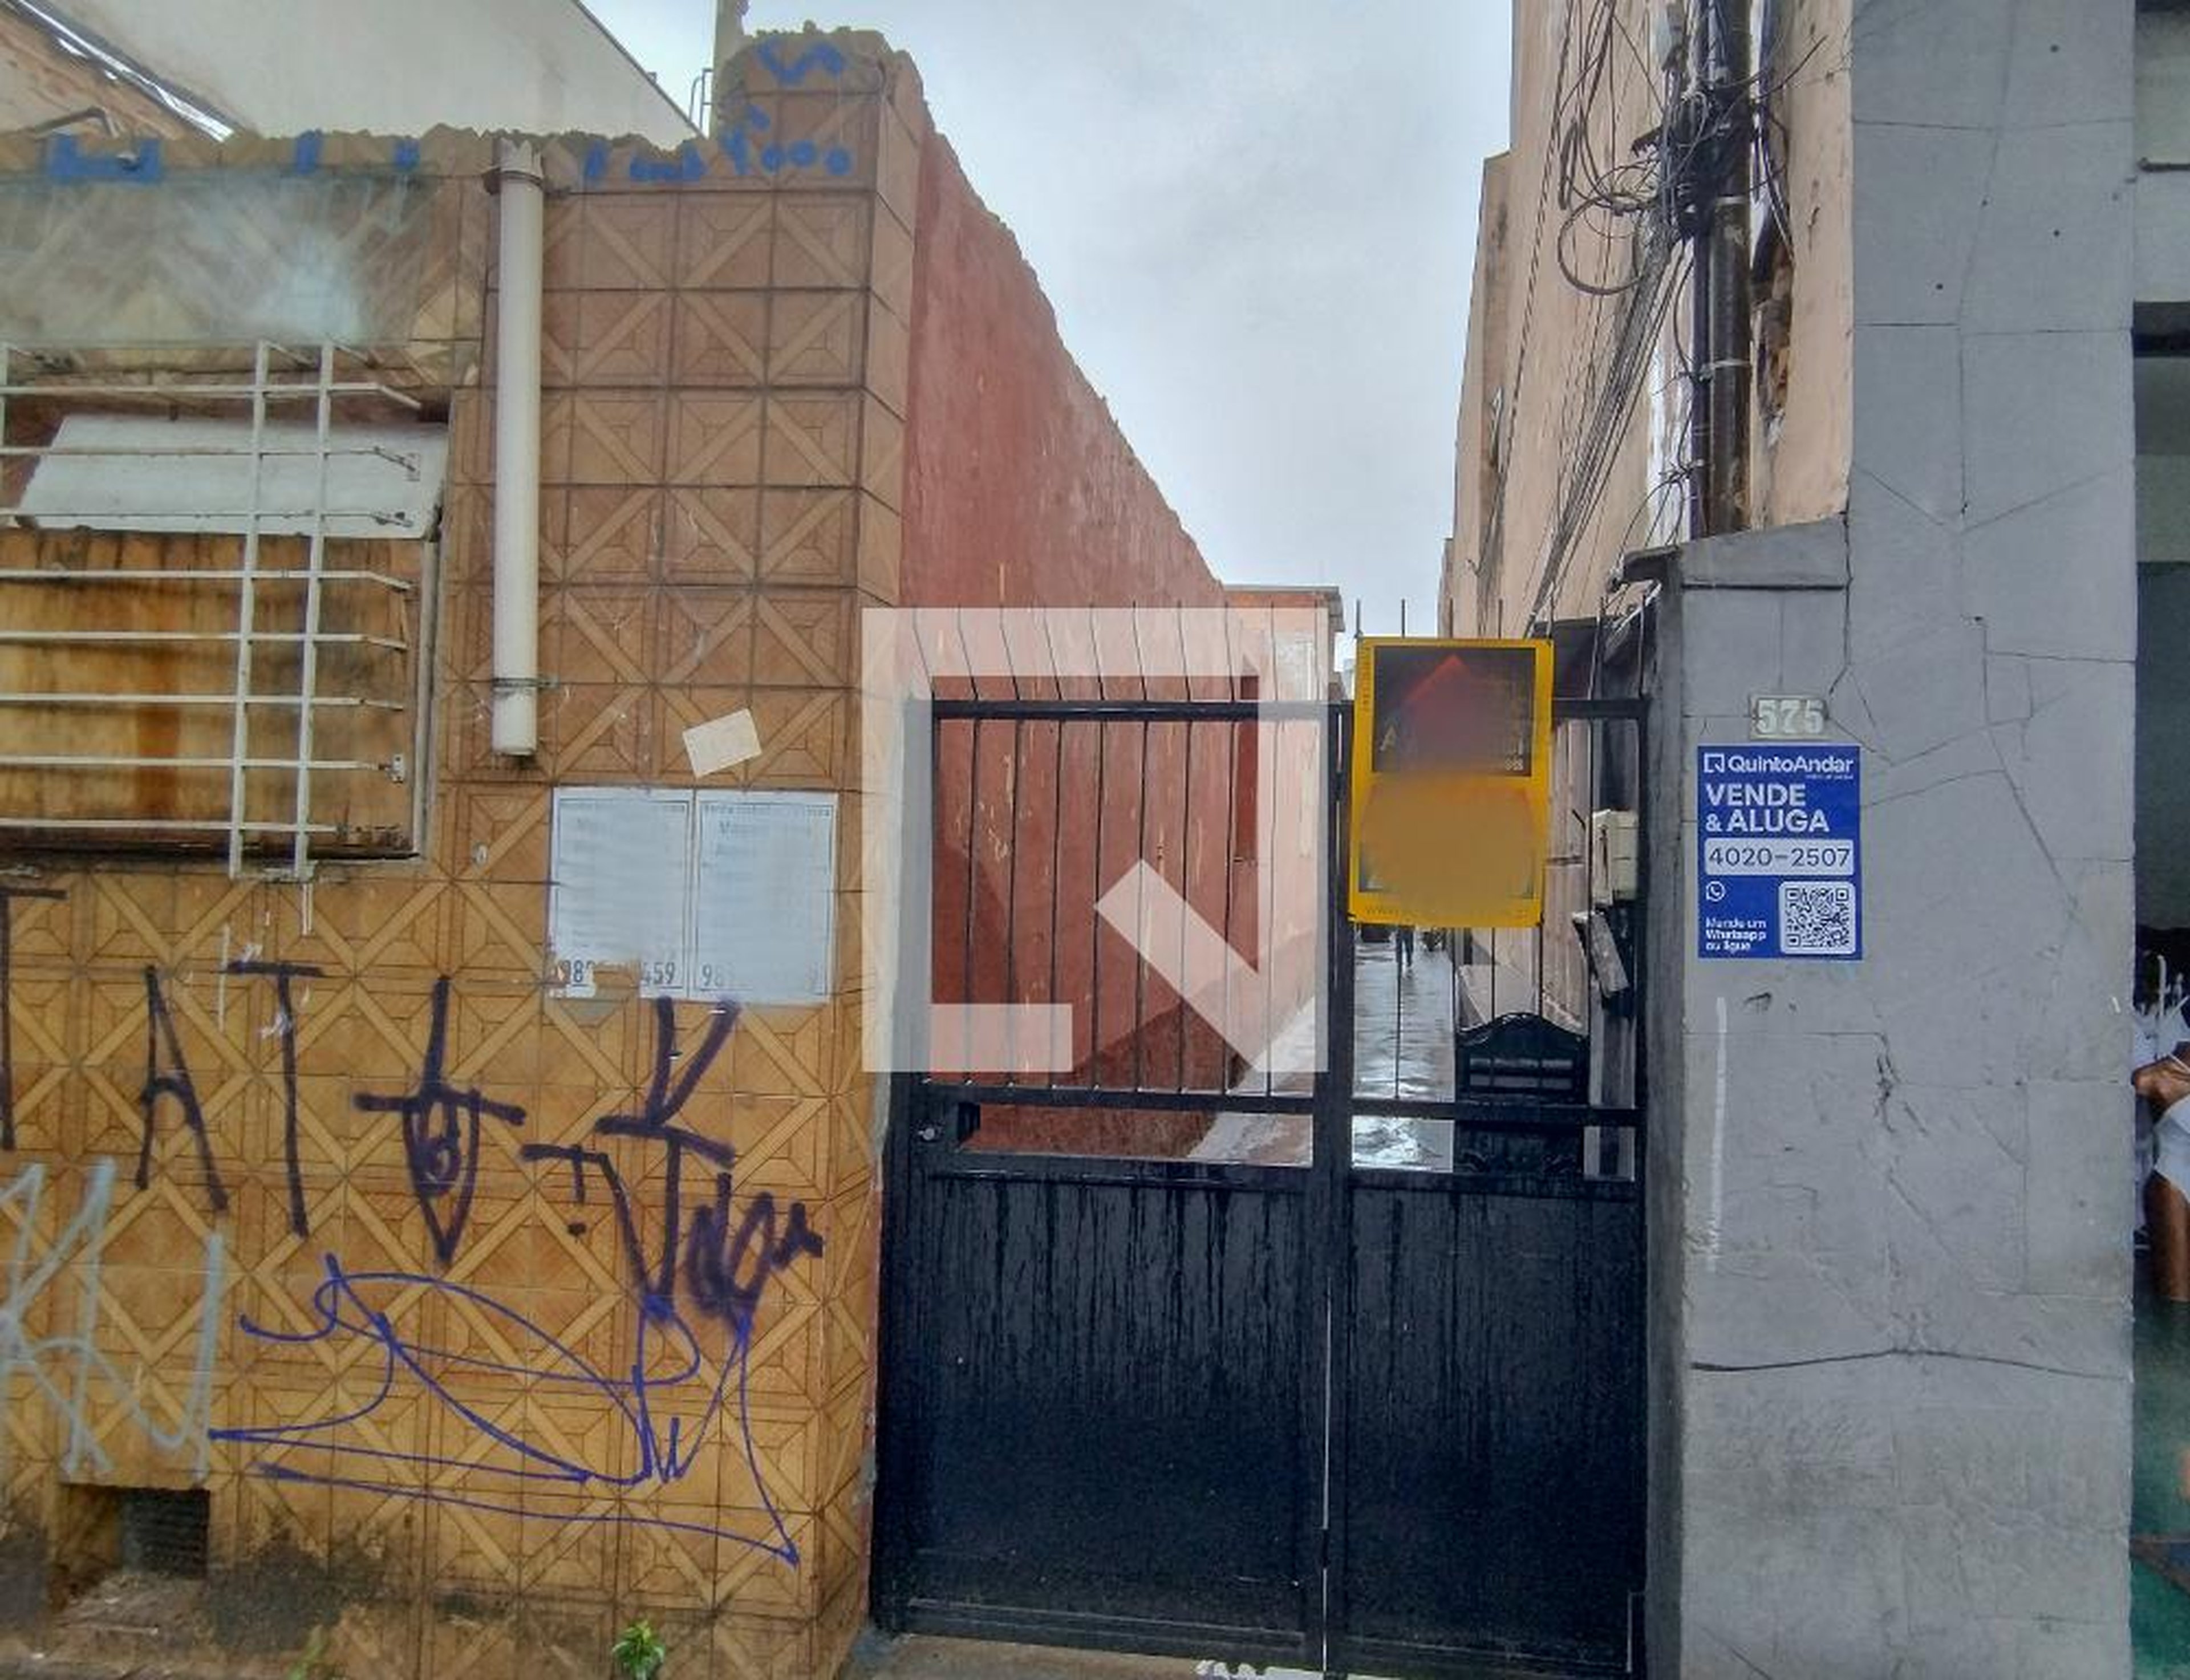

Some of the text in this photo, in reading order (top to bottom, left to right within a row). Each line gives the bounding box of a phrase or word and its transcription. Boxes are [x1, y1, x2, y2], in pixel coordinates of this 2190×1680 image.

[1757, 699, 1823, 734] 575
[1727, 755, 1854, 773] QuintoAndar
[1706, 784, 1806, 806] VENDE
[1706, 809, 1830, 832] & ALUGA
[1709, 847, 1851, 867] 4020-2507
